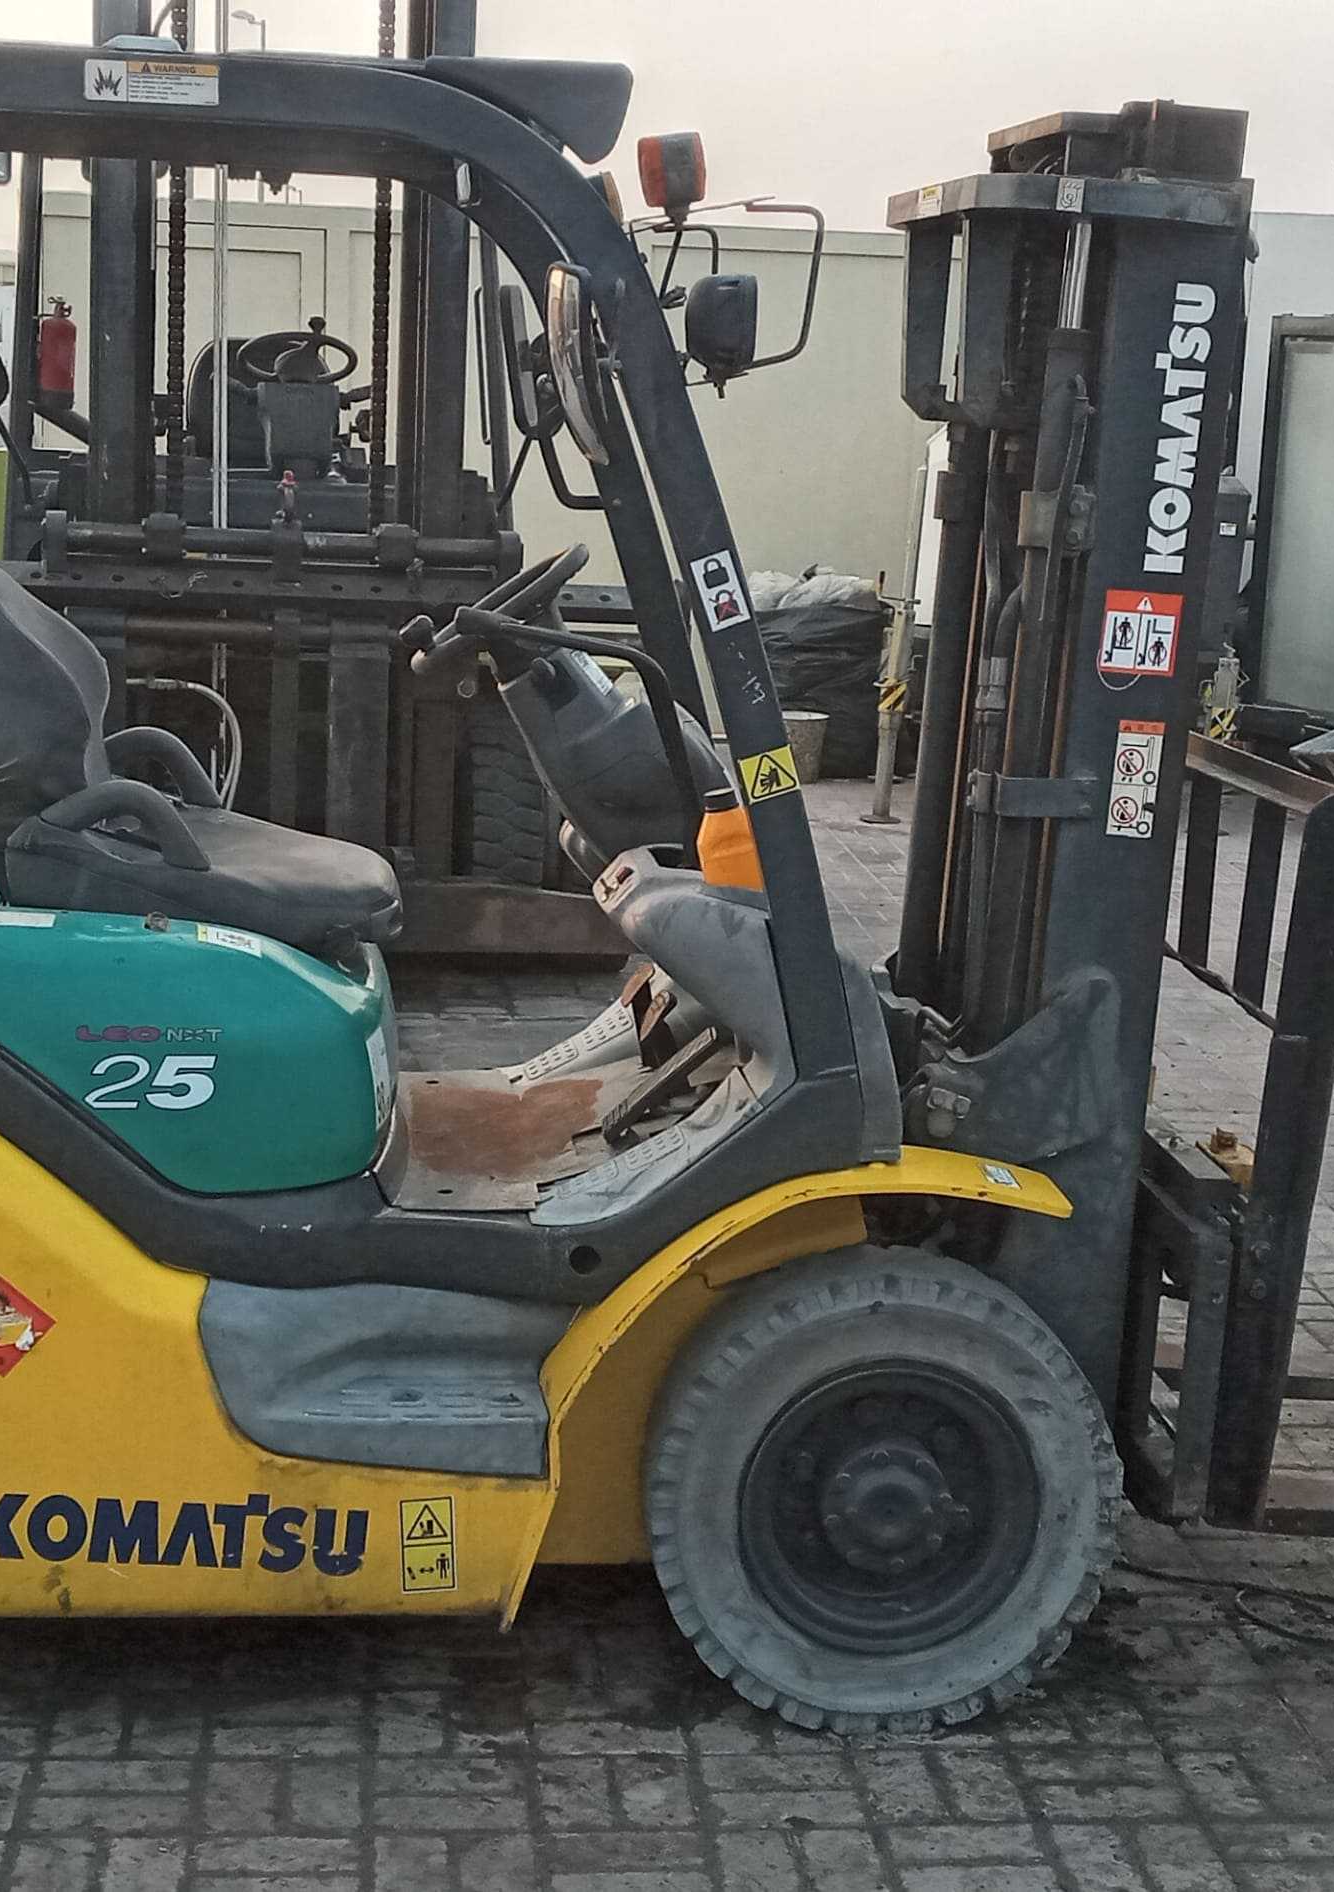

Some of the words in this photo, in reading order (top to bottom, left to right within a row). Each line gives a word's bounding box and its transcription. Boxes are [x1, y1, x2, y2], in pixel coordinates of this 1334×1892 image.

[154, 64, 196, 74] WARNING
[1143, 282, 1216, 574] KOMATSU
[75, 1024, 162, 1042] LEO
[166, 1027, 223, 1042] NXT
[83, 1053, 219, 1111] 25
